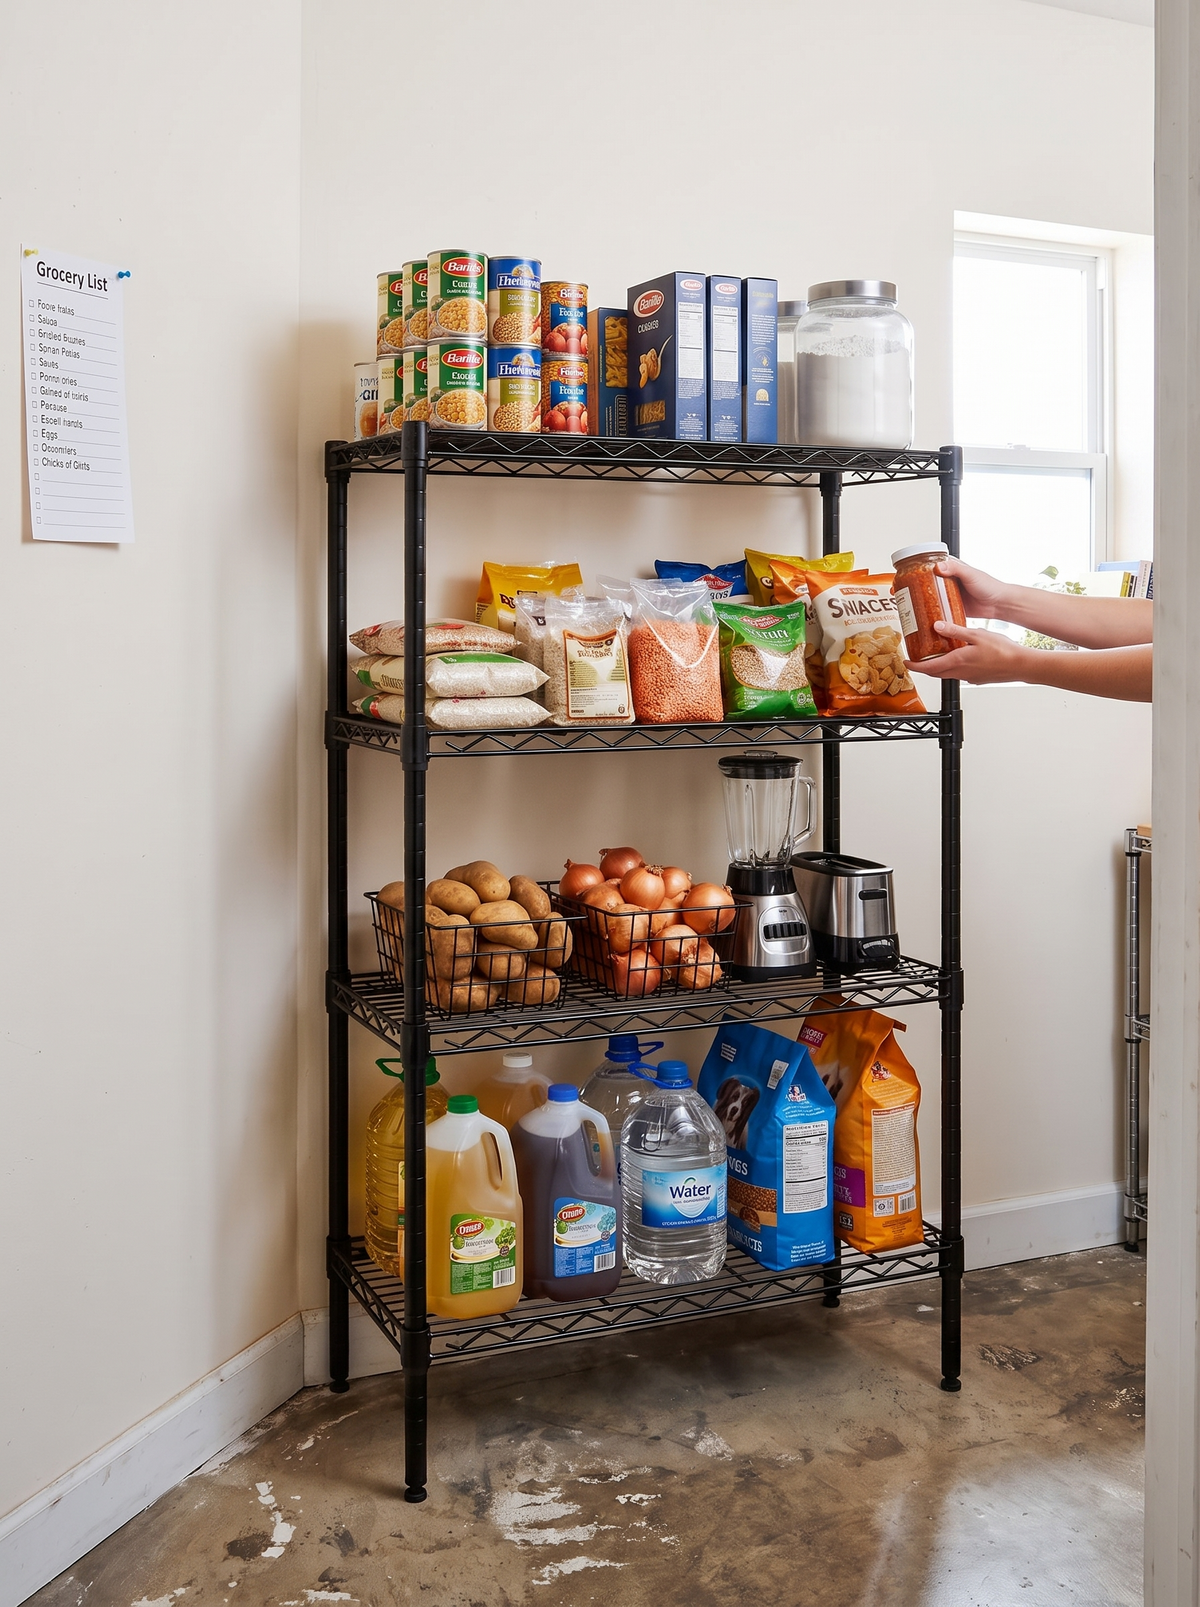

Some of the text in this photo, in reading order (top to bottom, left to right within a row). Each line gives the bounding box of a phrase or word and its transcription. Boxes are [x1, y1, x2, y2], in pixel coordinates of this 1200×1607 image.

[36, 261, 108, 292] Grocery List
[63, 390, 71, 398] of
[41, 428, 58, 441] Eggs
[65, 460, 72, 469] of
[669, 1184, 712, 1199] Water
